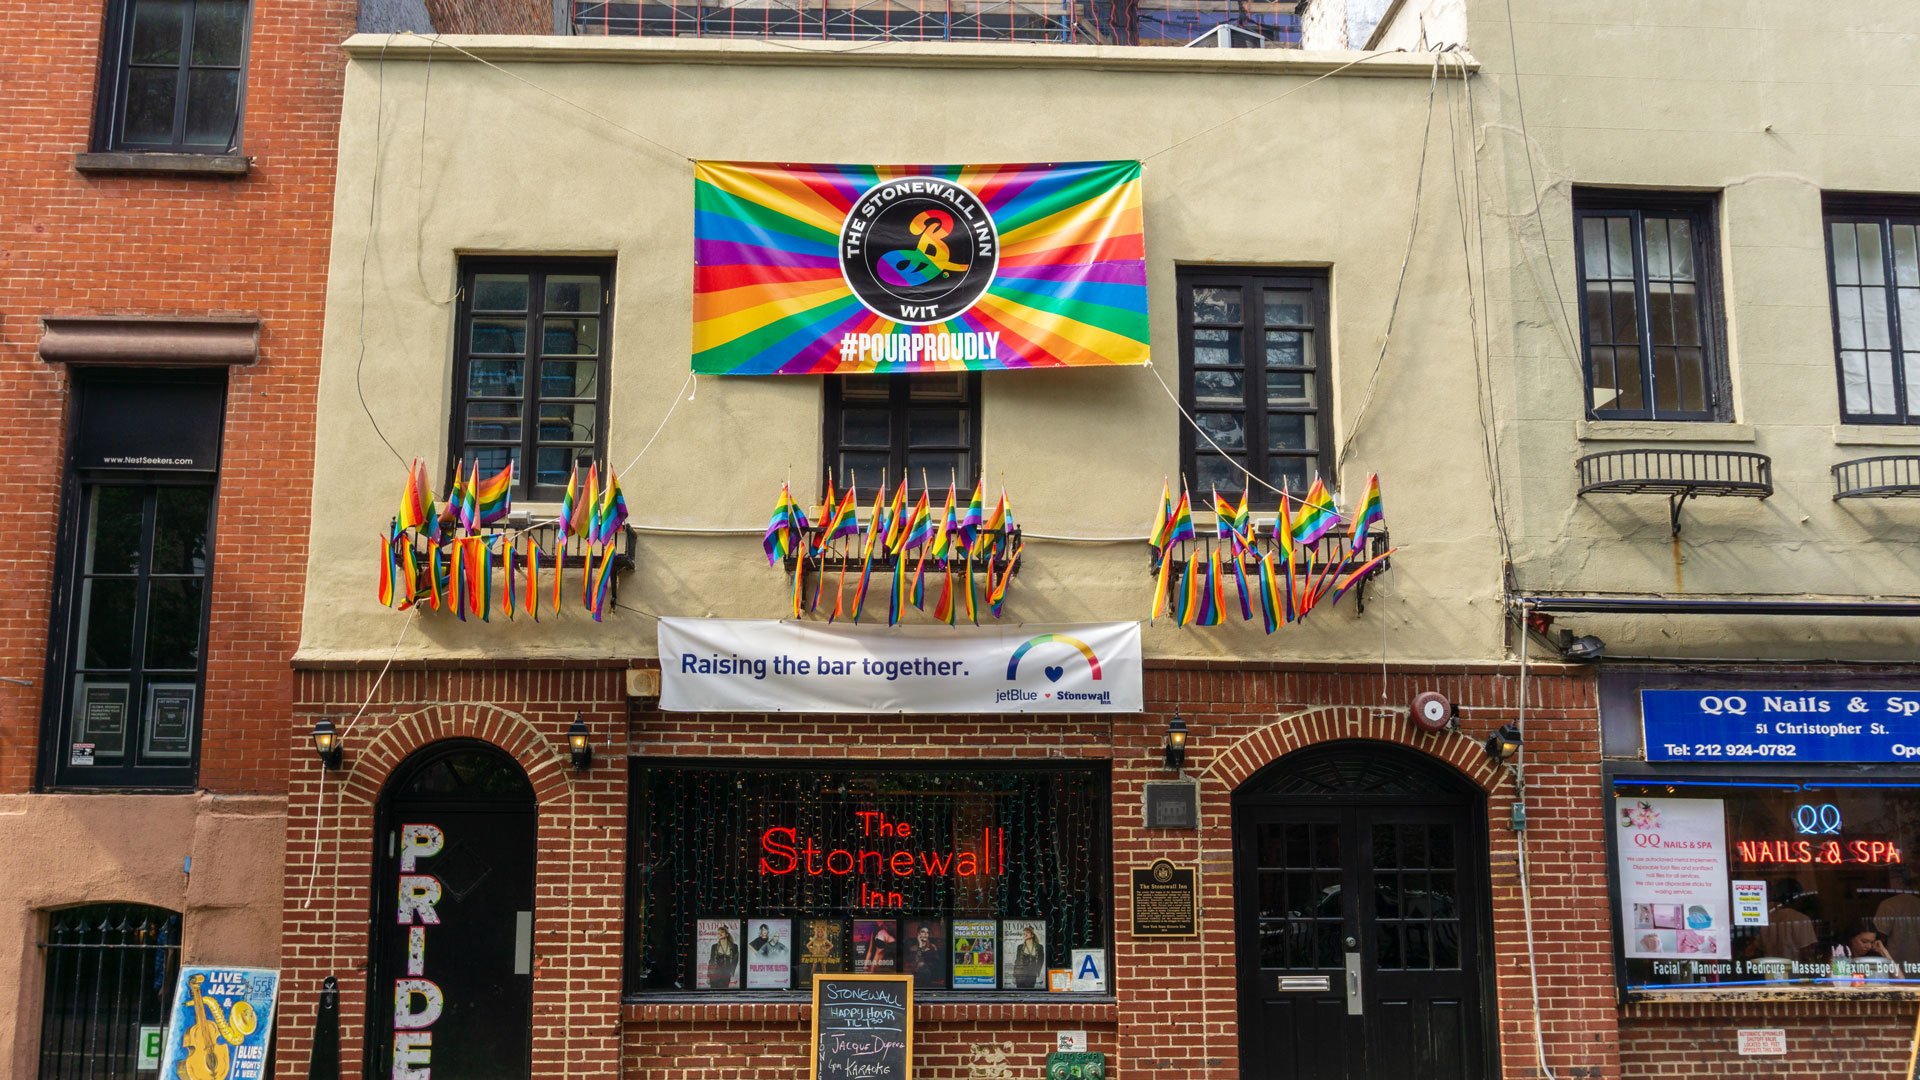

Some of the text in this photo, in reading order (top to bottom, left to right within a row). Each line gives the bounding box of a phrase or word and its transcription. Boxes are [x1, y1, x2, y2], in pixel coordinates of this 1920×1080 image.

[847, 181, 993, 259] THE STONEWALL INN
[900, 304, 939, 319] WIT
[840, 331, 1000, 362] #POURPROUDLY
[103, 456, 193, 465] www.NestSeekers.com
[681, 653, 969, 681] Raising the bar together.
[995, 689, 1110, 703] jetBlue Stonewall
[1700, 696, 1747, 715] QQ
[1763, 697, 1831, 713] Nails
[1847, 697, 1869, 713] &
[1755, 722, 1890, 736] 51 Christopher St.
[1664, 744, 1796, 756] Tel: 212 924-0782
[856, 811, 911, 837] The
[1797, 803, 1841, 835] QQ
[1634, 833, 1661, 848] QQ
[1663, 841, 1687, 849] NAILS
[1697, 841, 1712, 849] SPA
[761, 827, 1004, 876] Stonewall
[1741, 840, 1901, 864] NAILS & SPA
[861, 882, 903, 908] Inn
[392, 823, 444, 1080] PRIDE
[1078, 954, 1100, 979] A
[1653, 961, 1680, 975] Facial
[1691, 961, 1732, 974] Manicure
[1735, 961, 1743, 974] &
[1746, 961, 1786, 974] Pedicure
[1876, 961, 1900, 977] Body
[209, 972, 242, 983] LIVE
[254, 980, 267, 992] 55
[208, 984, 245, 996] JAZZ
[826, 983, 902, 1007] STONEWALL
[223, 997, 232, 1007] &
[830, 1006, 896, 1021] HAPPY HOUR
[146, 1033, 163, 1058] B
[238, 1045, 263, 1059] BLUES
[241, 1060, 261, 1069] NIGHTS
[844, 1058, 891, 1077] KARAOKE
